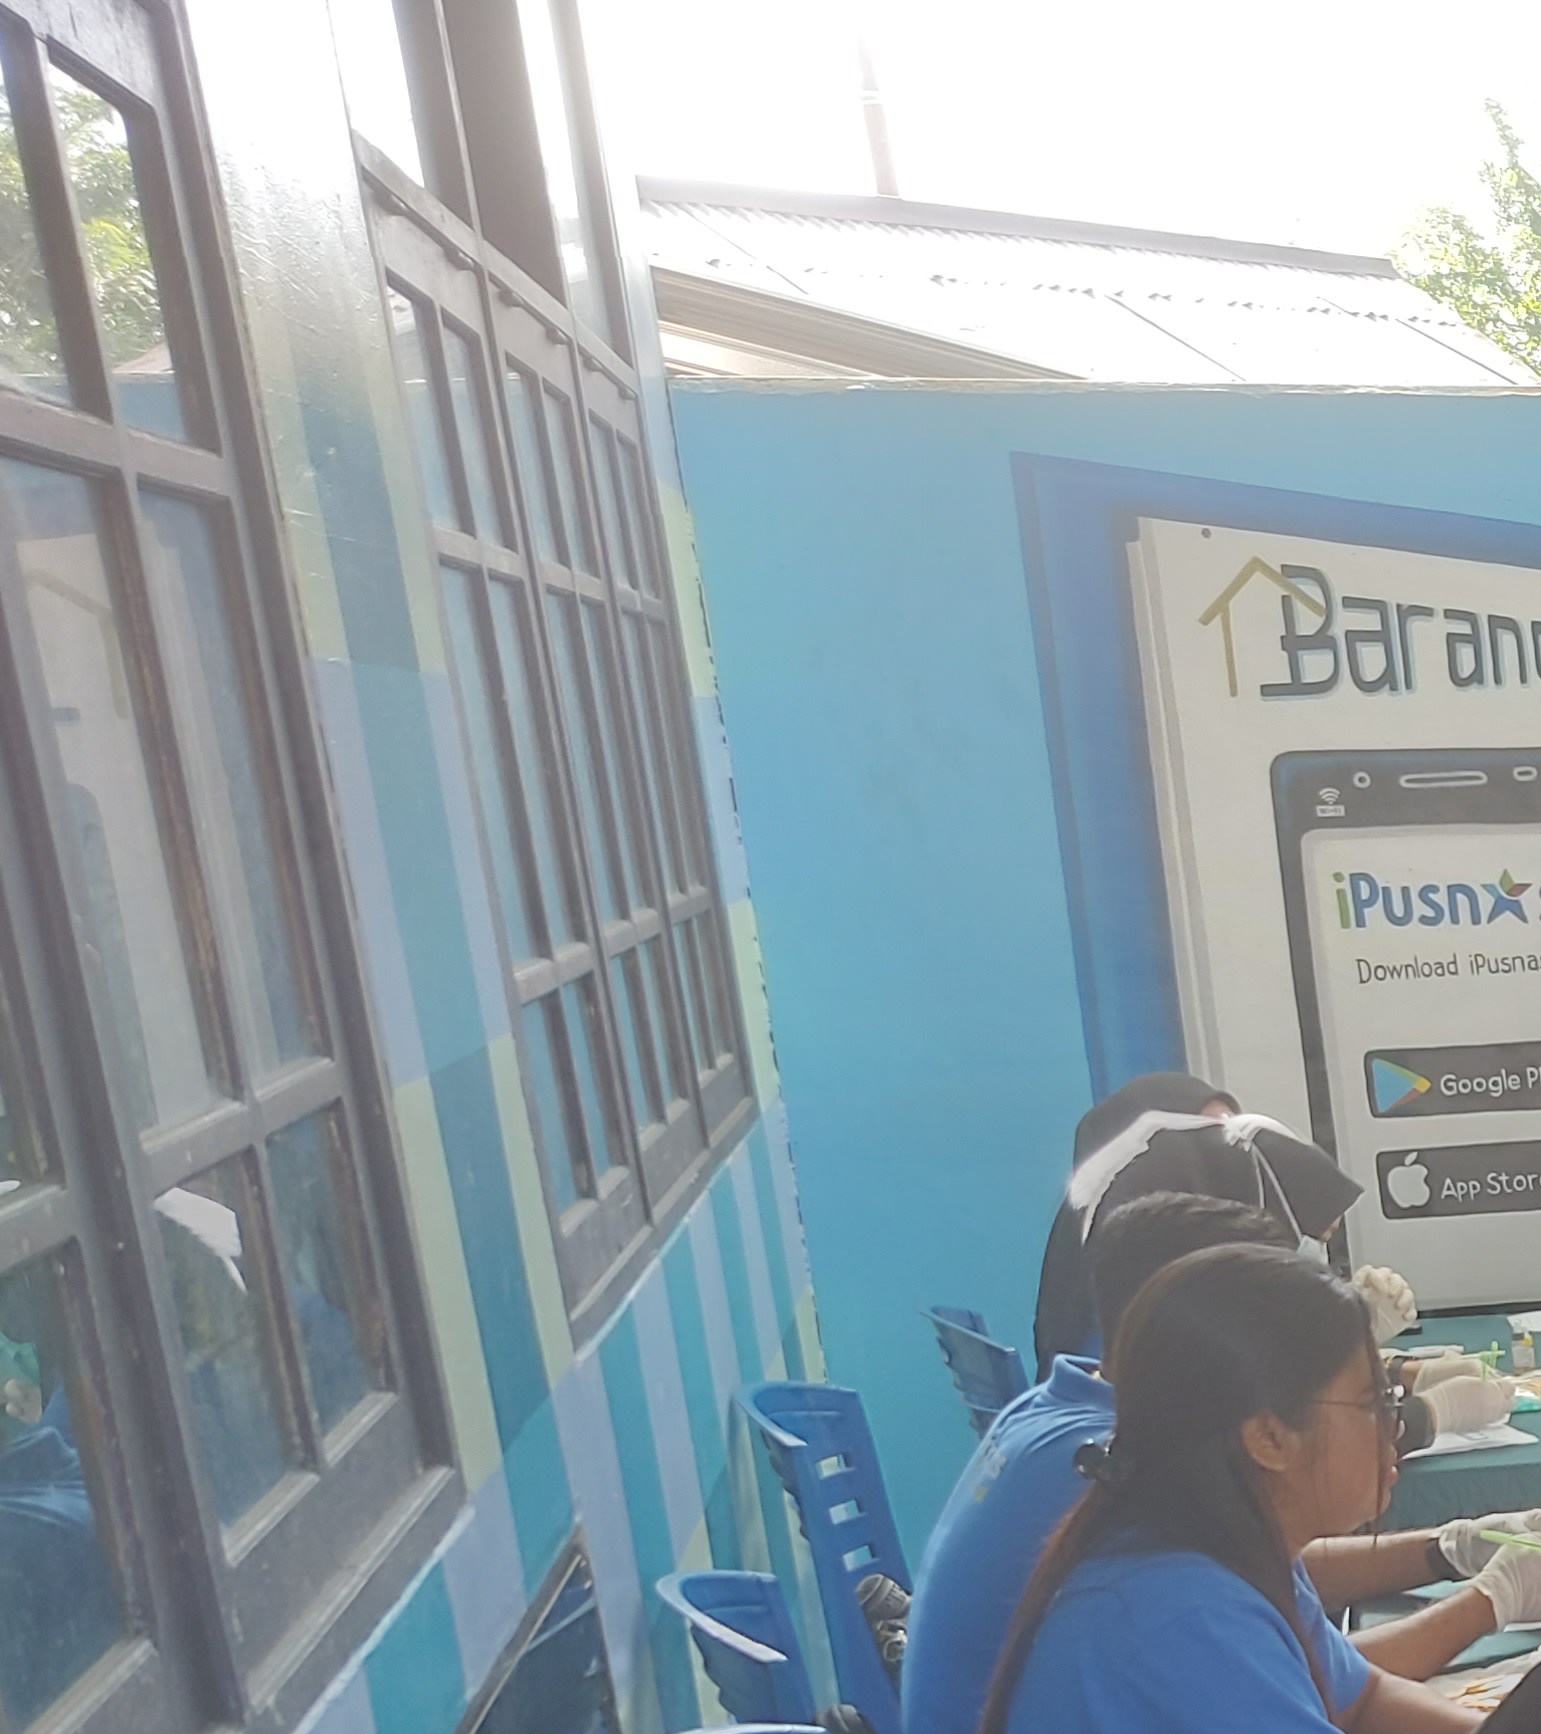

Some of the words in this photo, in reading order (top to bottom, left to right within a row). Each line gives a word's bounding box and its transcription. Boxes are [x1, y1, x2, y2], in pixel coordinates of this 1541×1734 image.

[1356, 954, 1459, 984] Download
[1440, 1068, 1521, 1098] Google
[1441, 1178, 1481, 1202] App
